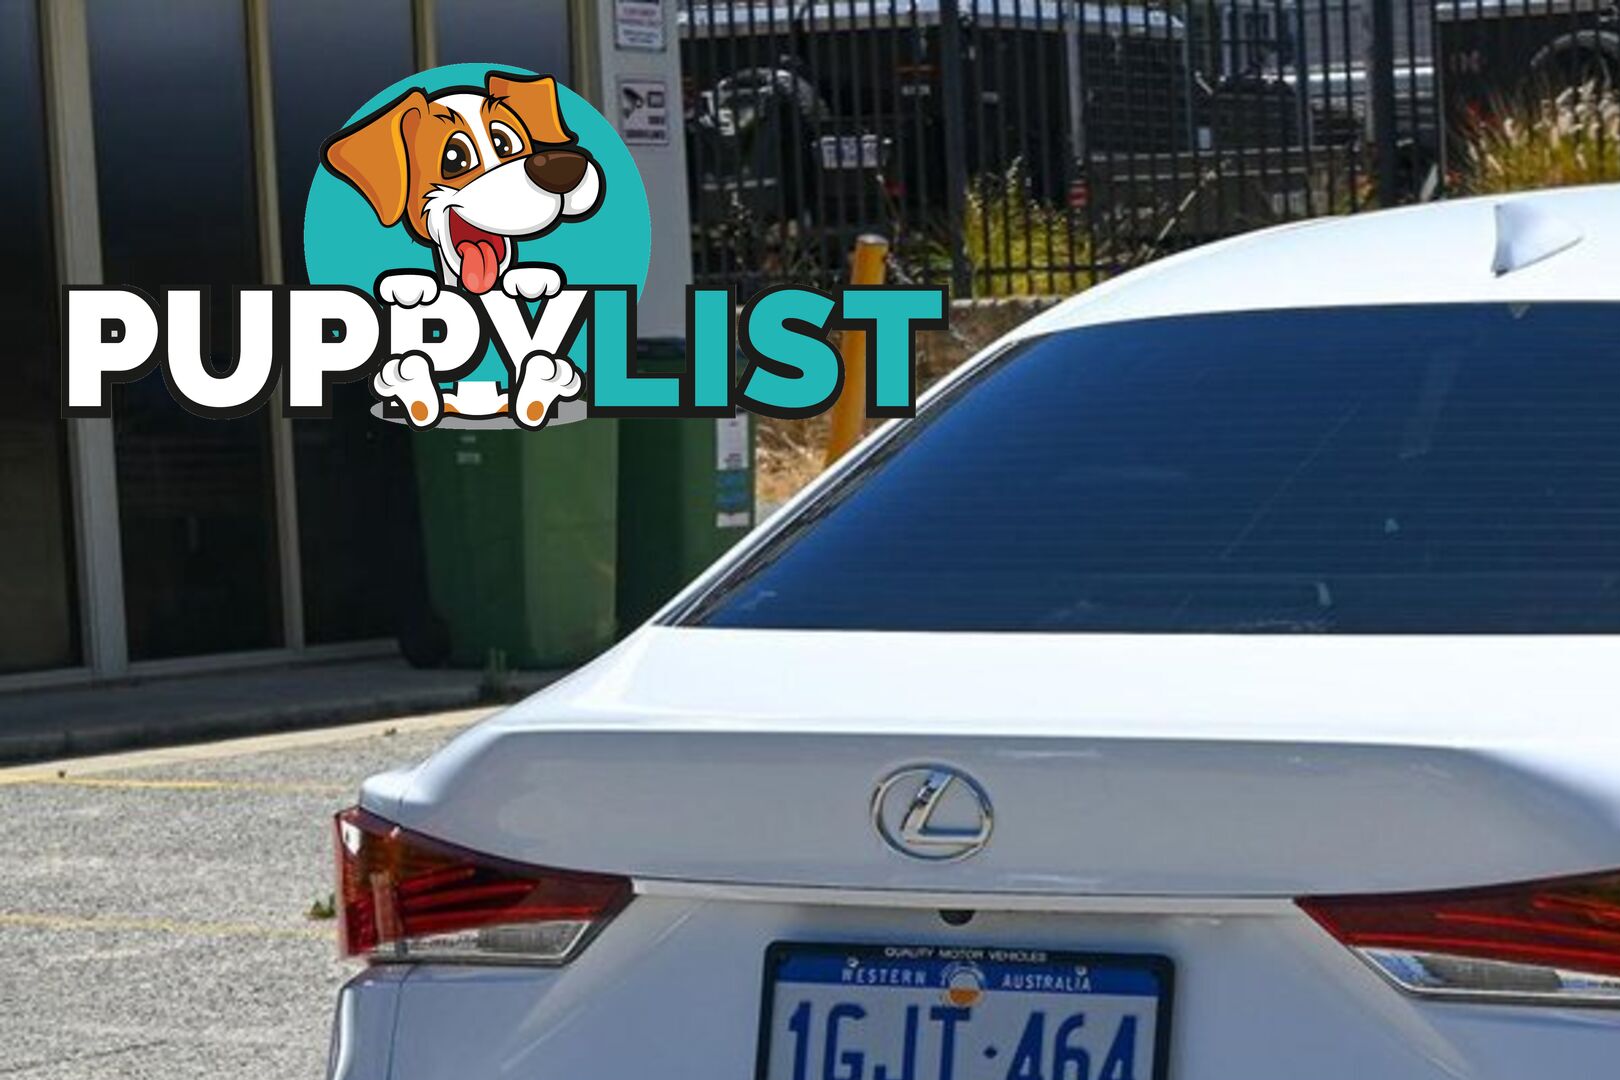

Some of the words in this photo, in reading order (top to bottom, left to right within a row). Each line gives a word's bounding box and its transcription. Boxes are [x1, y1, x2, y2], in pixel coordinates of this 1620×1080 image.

[884, 946, 934, 960] QUALITY
[938, 948, 985, 961] MOTOR
[988, 950, 1048, 964] VEHICLES
[841, 967, 928, 986] WESTERN
[1000, 973, 1093, 993] AUSTRALIA
